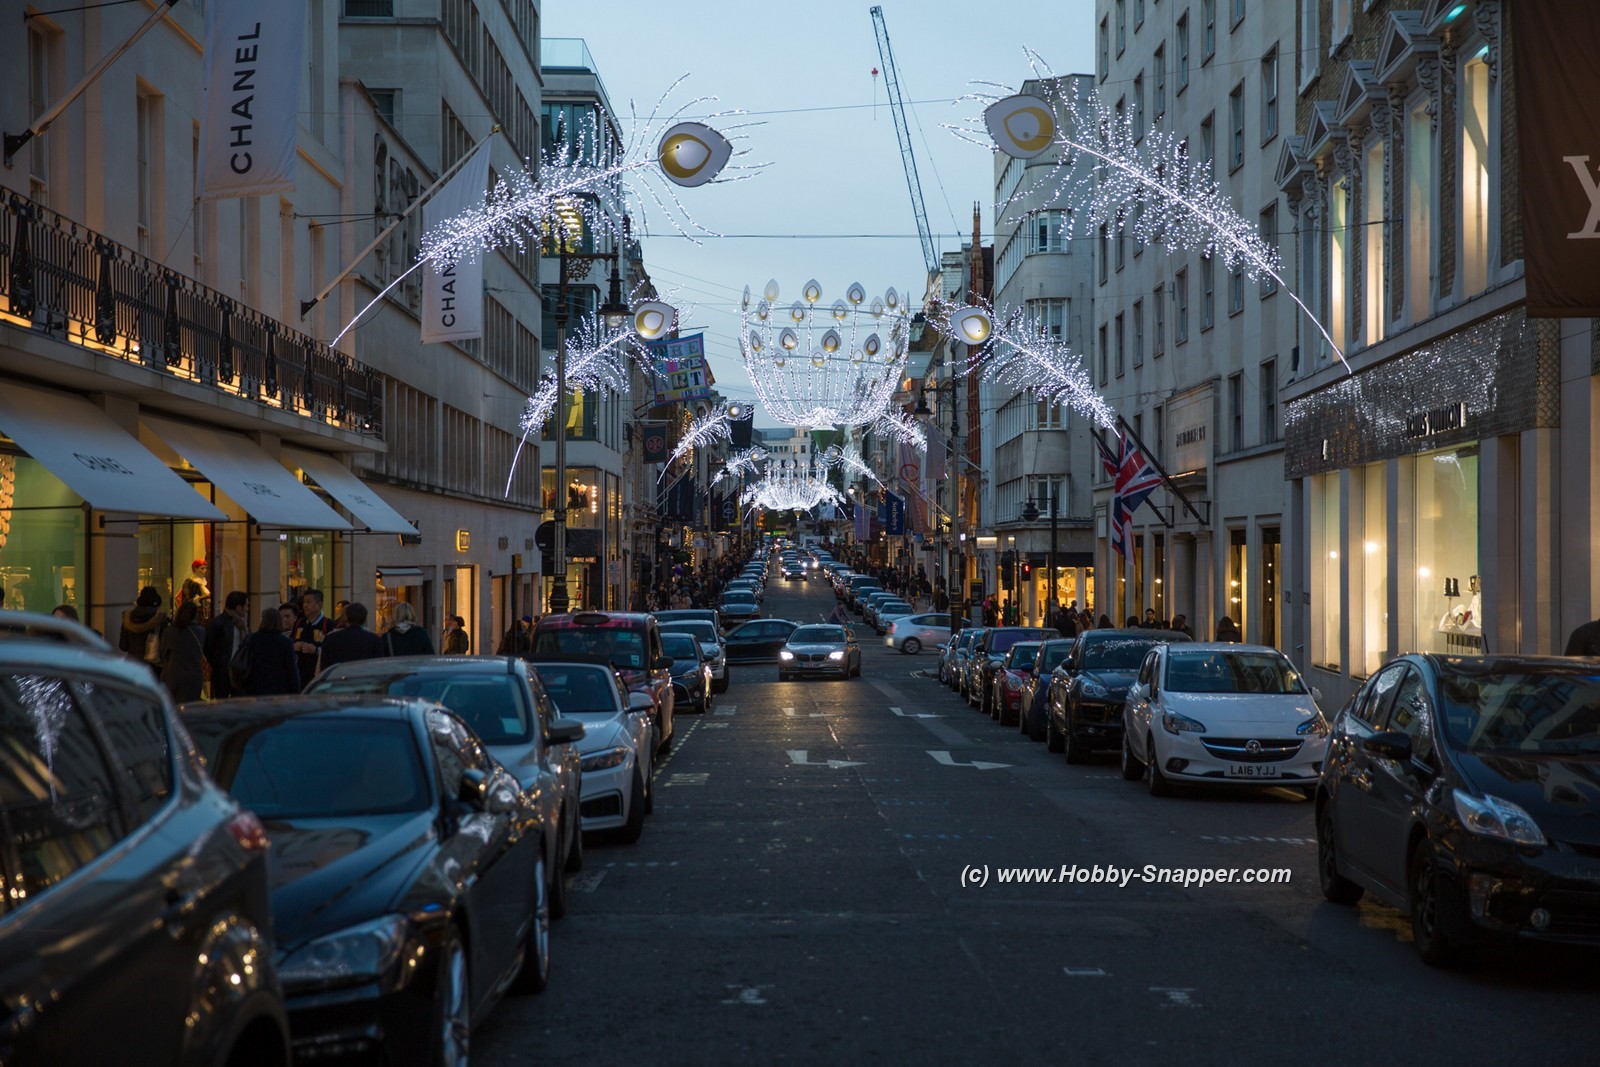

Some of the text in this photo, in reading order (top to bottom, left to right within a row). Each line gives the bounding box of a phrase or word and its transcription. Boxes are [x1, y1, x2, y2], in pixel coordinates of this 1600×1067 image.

[230, 22, 261, 175] CHANEL
[442, 247, 458, 328] CHAN
[1230, 765, 1276, 776] LA16 YJJ
